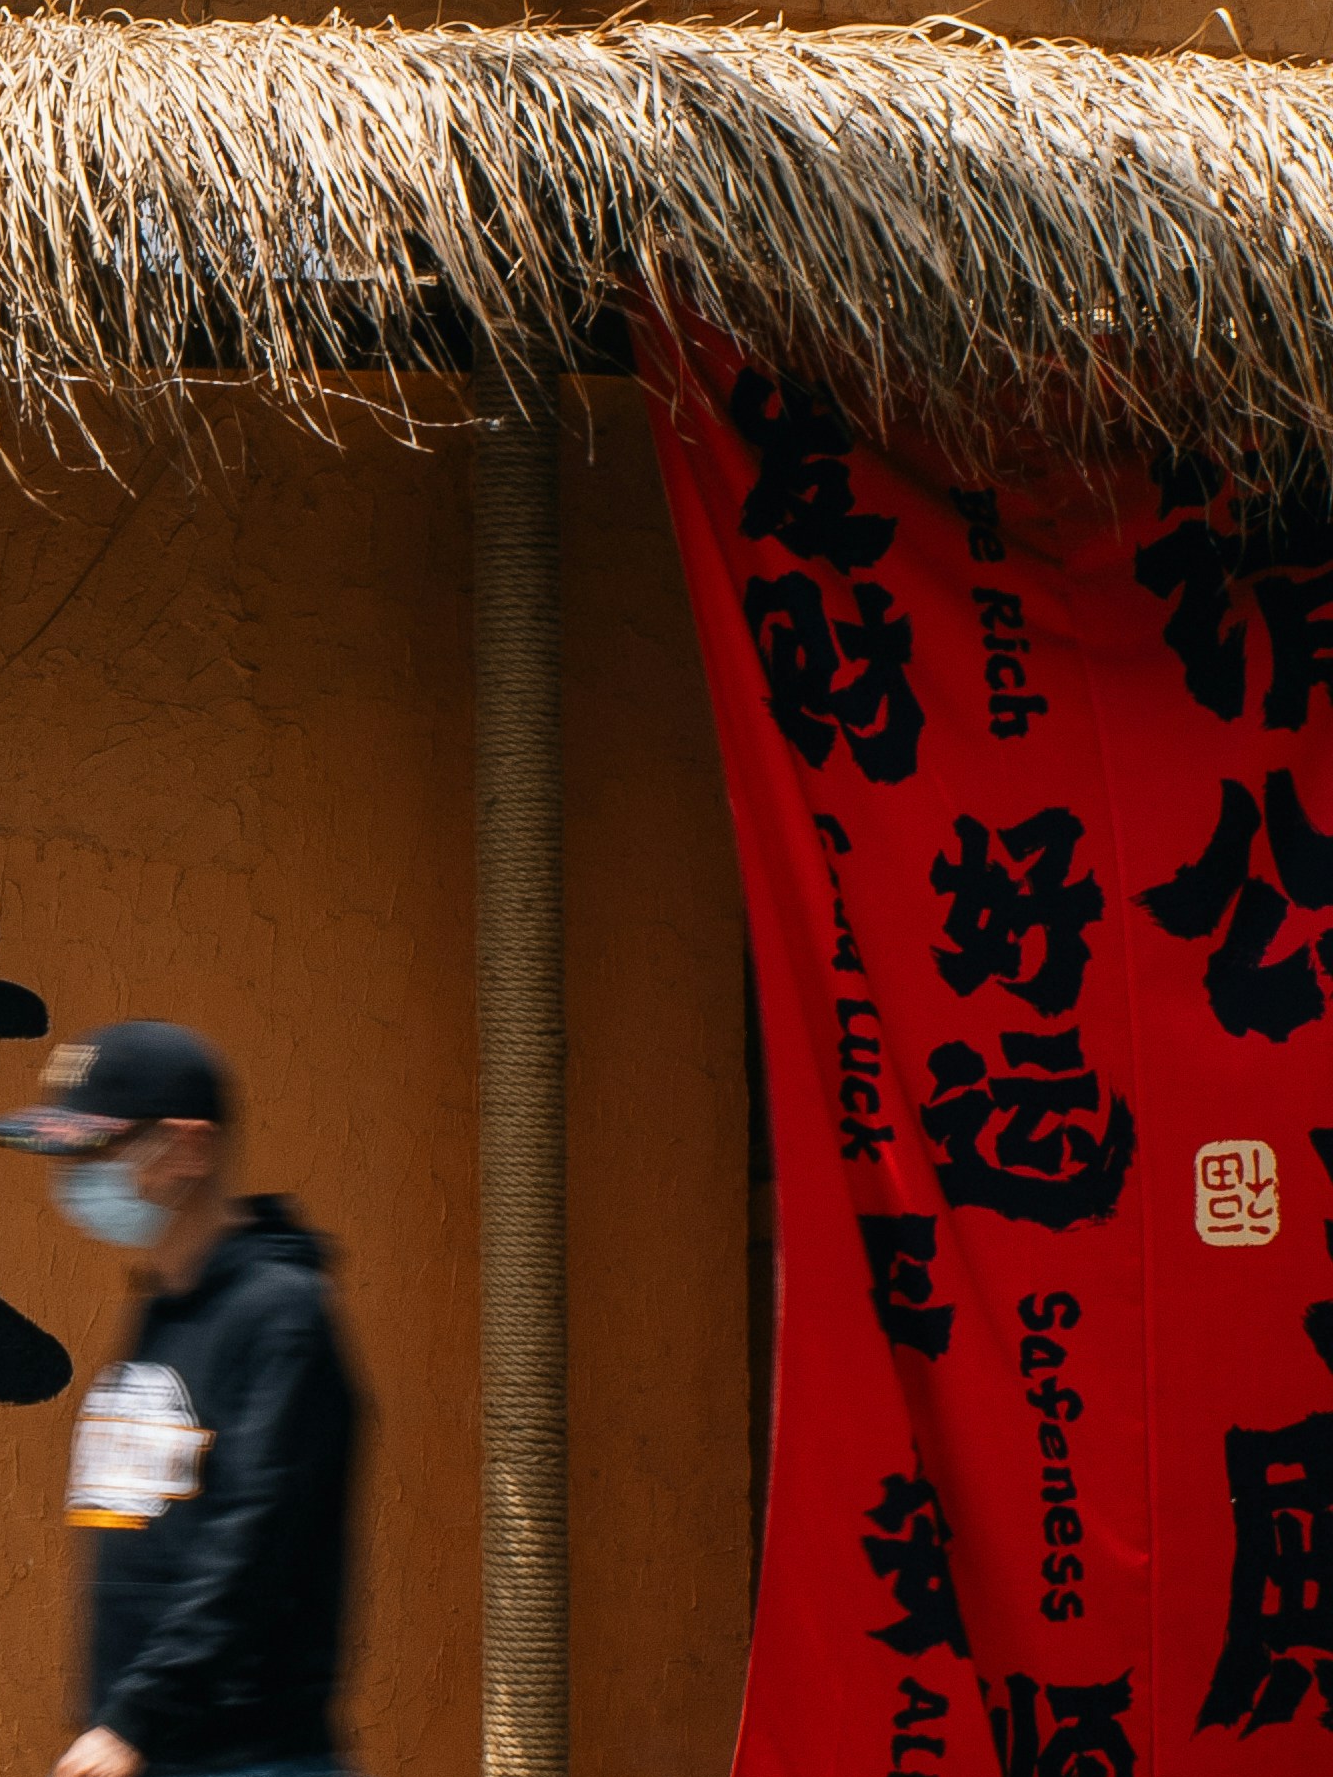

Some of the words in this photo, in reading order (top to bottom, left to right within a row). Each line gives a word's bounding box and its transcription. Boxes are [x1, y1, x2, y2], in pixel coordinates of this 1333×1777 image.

[971, 588, 1050, 740] Rich
[836, 998, 896, 1163] Luck
[920, 806, 1136, 1232] 好运
[1018, 1290, 1084, 1622] Safeness
